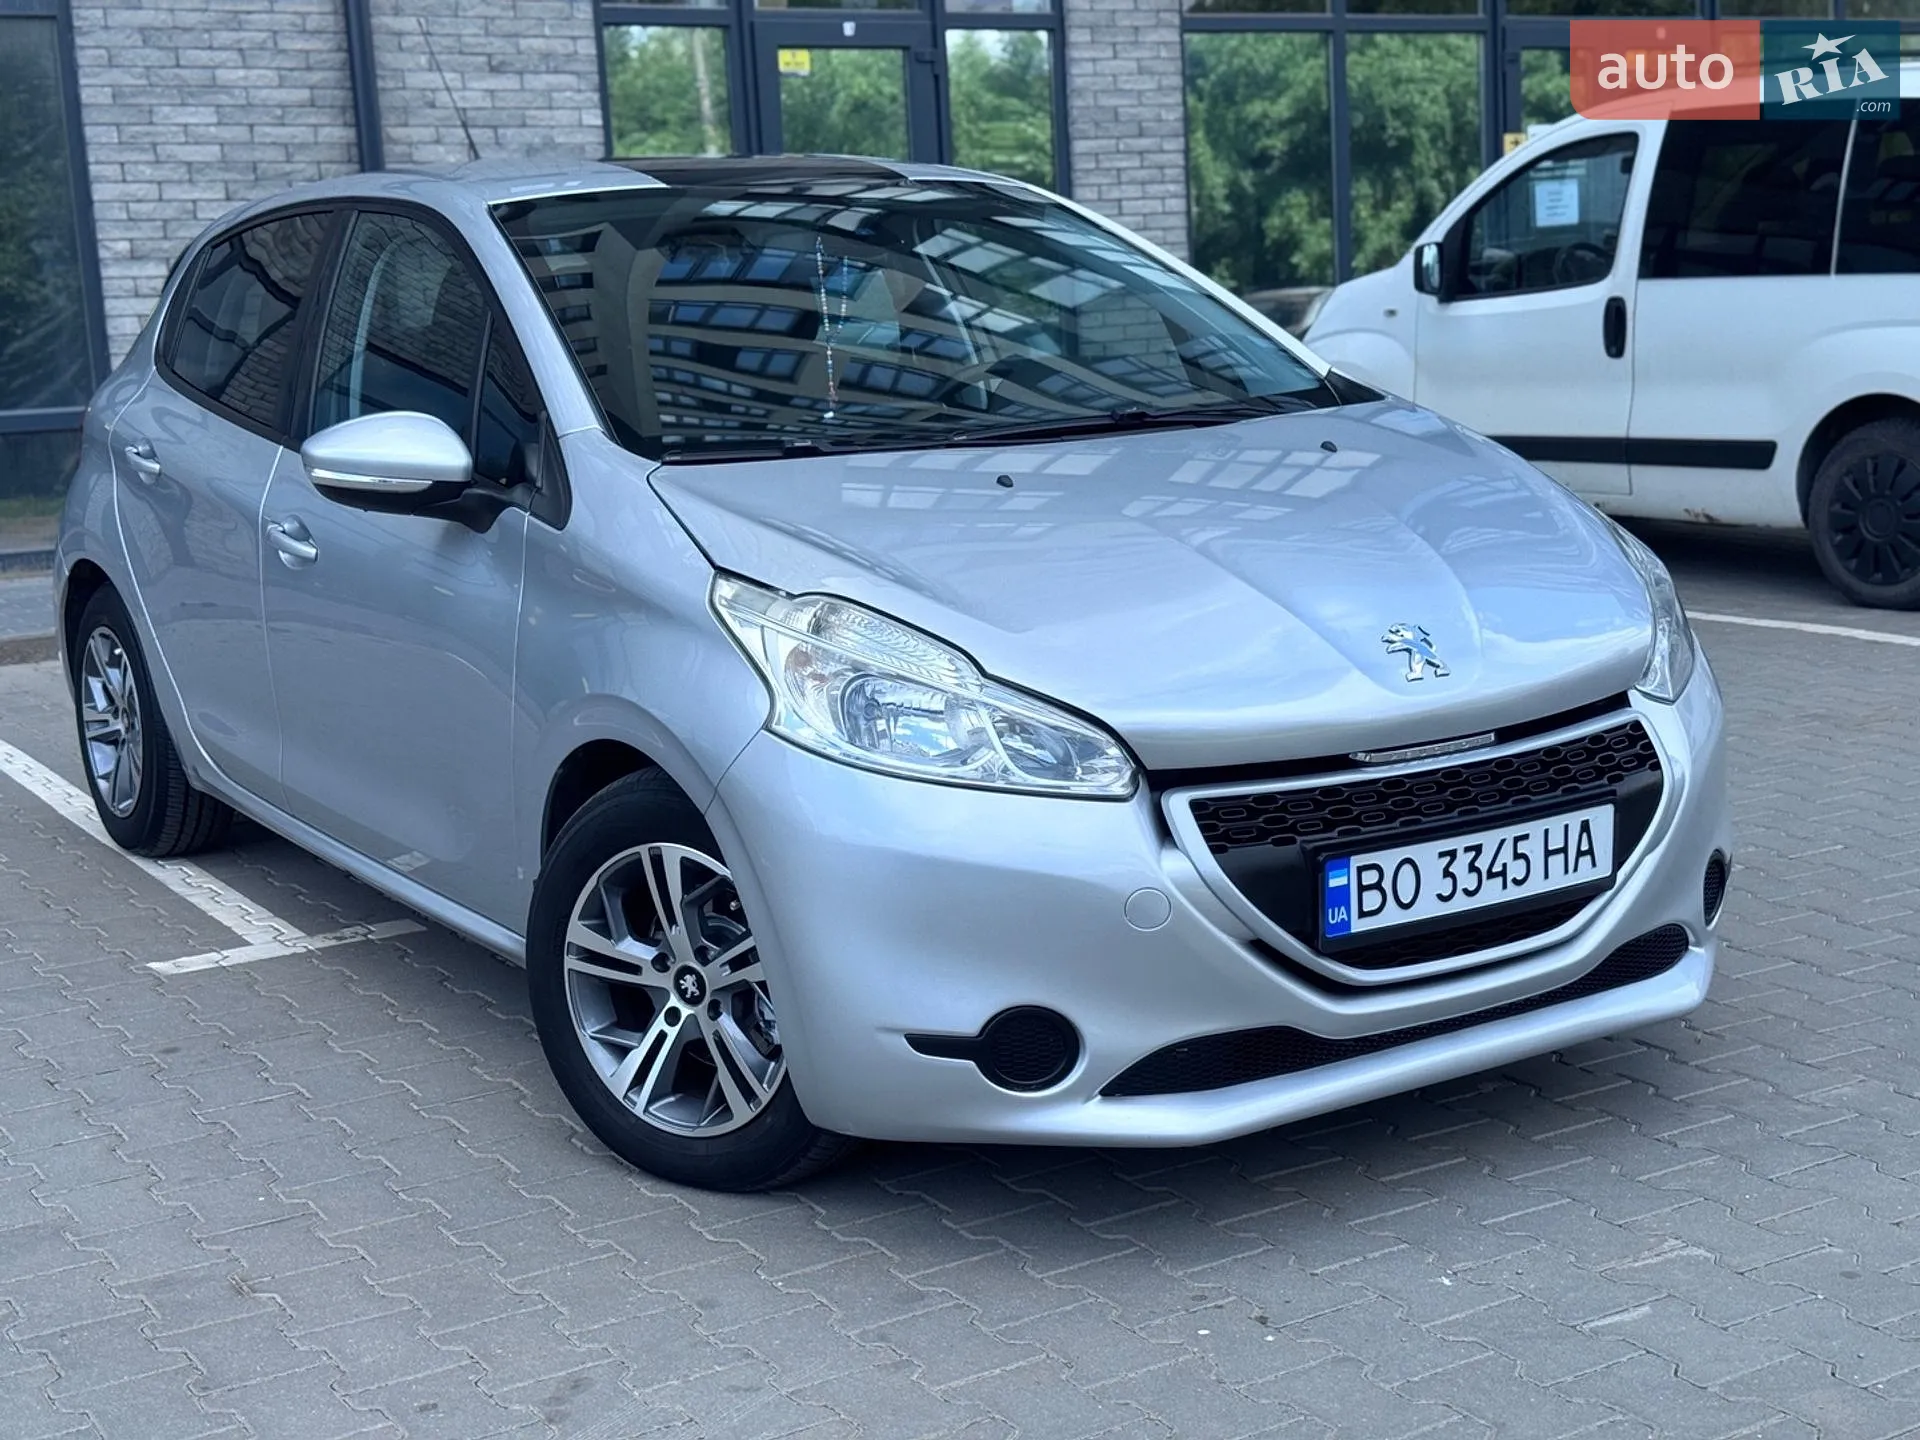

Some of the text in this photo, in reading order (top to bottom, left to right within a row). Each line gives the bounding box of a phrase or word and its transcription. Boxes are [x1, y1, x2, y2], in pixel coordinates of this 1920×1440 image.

[1356, 818, 1598, 919] BO 3345 HA
[1328, 905, 1349, 925] UA
